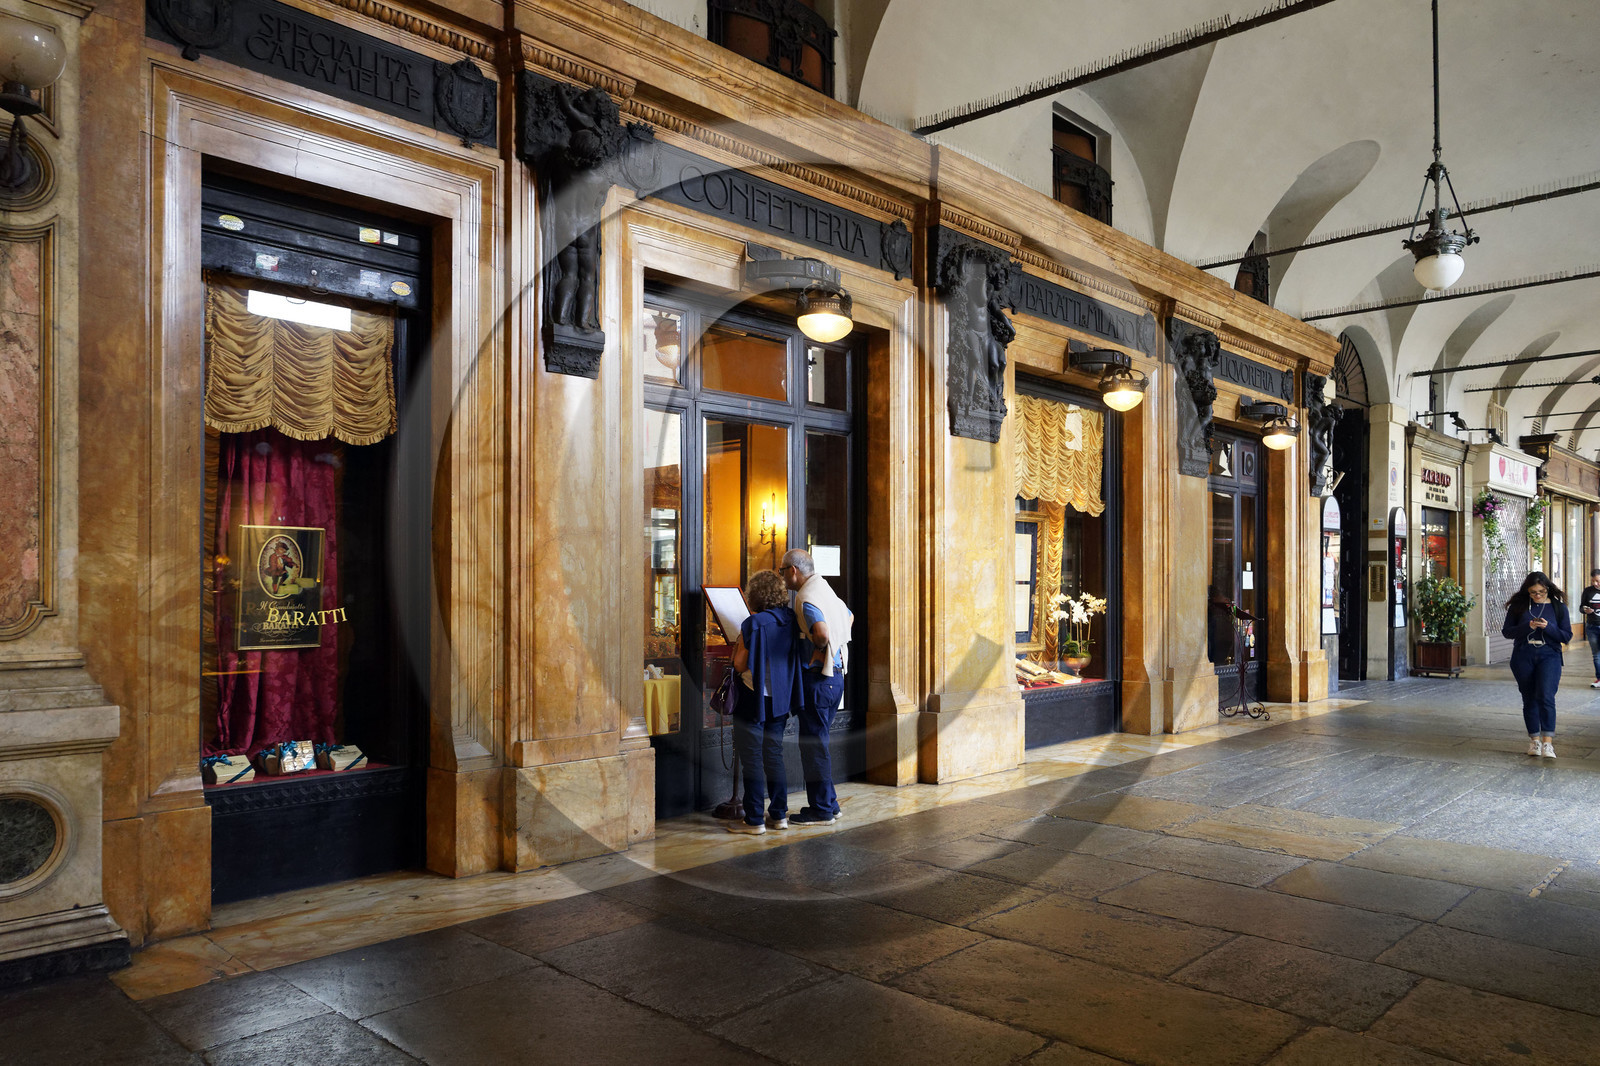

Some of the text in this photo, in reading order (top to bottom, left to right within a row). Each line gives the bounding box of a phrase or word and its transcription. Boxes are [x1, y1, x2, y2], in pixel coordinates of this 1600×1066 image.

[246, 36, 422, 113] CARAMELLE
[679, 164, 869, 258] CONFETTERIA
[1025, 281, 1082, 327] BARATTI
[1086, 303, 1135, 344] MILANO
[1219, 355, 1275, 393] LIQVORERIA
[266, 607, 348, 626] BARATTI
